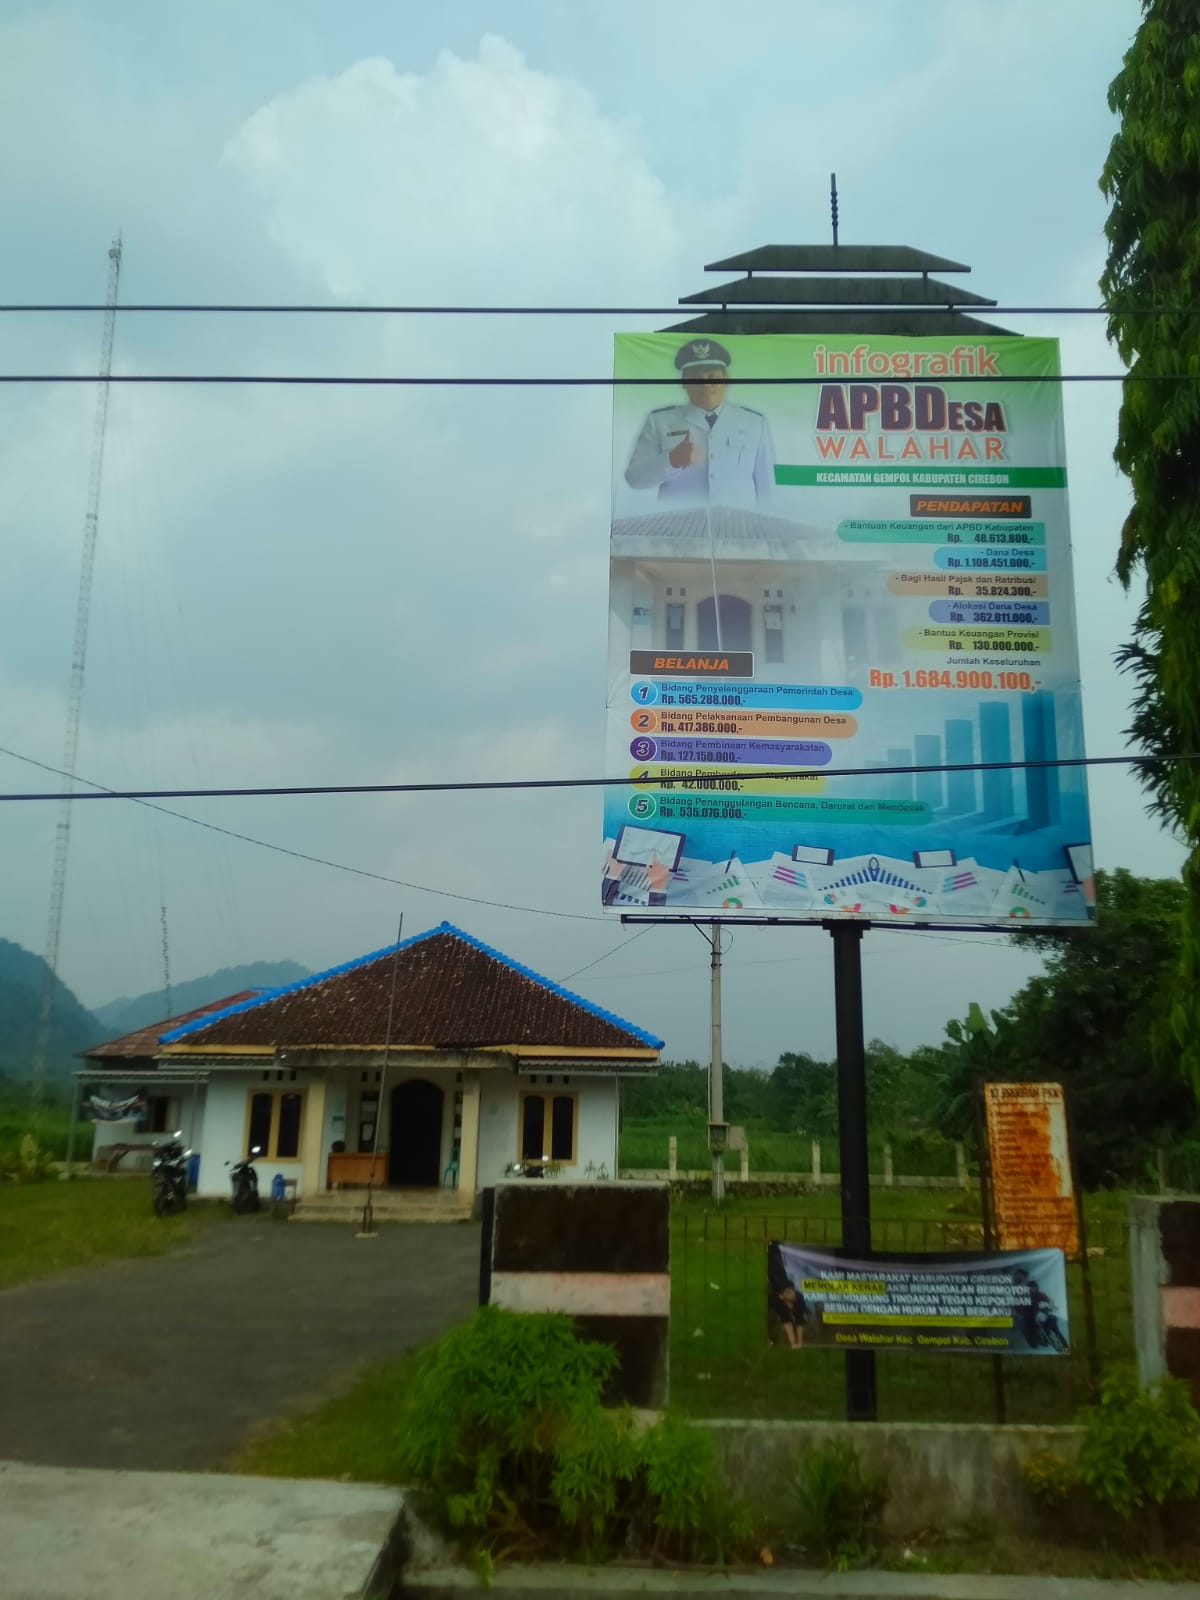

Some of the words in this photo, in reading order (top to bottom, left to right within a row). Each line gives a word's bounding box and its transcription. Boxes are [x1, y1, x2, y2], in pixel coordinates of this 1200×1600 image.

[813, 345, 999, 378] infografik
[815, 436, 1005, 460] WALAHAR
[816, 472, 872, 483] KECAMATAN
[873, 473, 911, 484] GEMPOL
[912, 474, 967, 484] KABUPATEN
[967, 474, 1010, 485] CIREBON
[916, 500, 1024, 513] PENDAPATAN
[850, 522, 887, 530] Bantuan
[889, 522, 934, 532] Keuangan
[936, 523, 953, 531] dari
[955, 523, 983, 531] APBD
[984, 524, 1034, 533] Kabupaten
[947, 533, 963, 543] Rp.
[986, 548, 1009, 556] Dana
[1011, 549, 1035, 557] Desa
[947, 557, 963, 567] Rp.
[901, 574, 922, 584] Bagi
[924, 574, 946, 582] Hasil
[949, 575, 973, 585] Pajak
[976, 575, 992, 583] dan
[995, 576, 1036, 584] Retribusi
[948, 585, 964, 596] Rp.
[952, 602, 986, 610] Alokasi
[988, 602, 1012, 611] Dana
[1014, 603, 1038, 611] Desa
[950, 612, 966, 622] Rp.
[924, 629, 957, 637] Bantua
[959, 630, 1005, 640] Keuangan
[1007, 630, 1040, 639] Provisi
[949, 640, 965, 651] Rp.
[653, 658, 730, 671] BELANJA
[947, 656, 981, 665] Jumlah
[982, 658, 1041, 667] Keseluruhan
[869, 669, 899, 689] Rp.
[902, 670, 1043, 692] 1.684.900.100,-
[637, 686, 649, 700] 1
[661, 683, 693, 694] Bidang
[695, 684, 774, 696] Penyelenggaraan
[776, 686, 828, 697] Pemerintah
[830, 688, 854, 697] Desa
[661, 694, 677, 706] Rp.
[638, 714, 649, 728] 2
[661, 711, 693, 723] Bidang
[695, 712, 753, 722] Pelaksanaan
[755, 713, 821, 725] Pembangunan
[823, 715, 847, 725] Desa
[661, 722, 677, 733] Rp.
[636, 741, 650, 757] 3
[661, 739, 693, 751] Bidang
[695, 740, 747, 750] Pembinaan
[749, 742, 825, 753] Kemasyarakatan
[661, 750, 676, 762] Rp.
[635, 799, 648, 813] 5
[660, 796, 692, 808] Bidang
[695, 797, 773, 810] Penanggulangan
[821, 801, 856, 810] Darurat
[858, 802, 875, 810] dan
[659, 806, 676, 818] Rp.
[820, 1270, 844, 1280] KAMI
[846, 1271, 911, 1282] MASYARAKAT
[909, 1284, 975, 1294] BERANDALAN
[976, 1285, 1031, 1296] BERMOTOR
[892, 1294, 939, 1305] TINDAKAN
[941, 1296, 974, 1305] TEGAS
[860, 1303, 901, 1314] DENGAN
[938, 1306, 966, 1315] YANG
